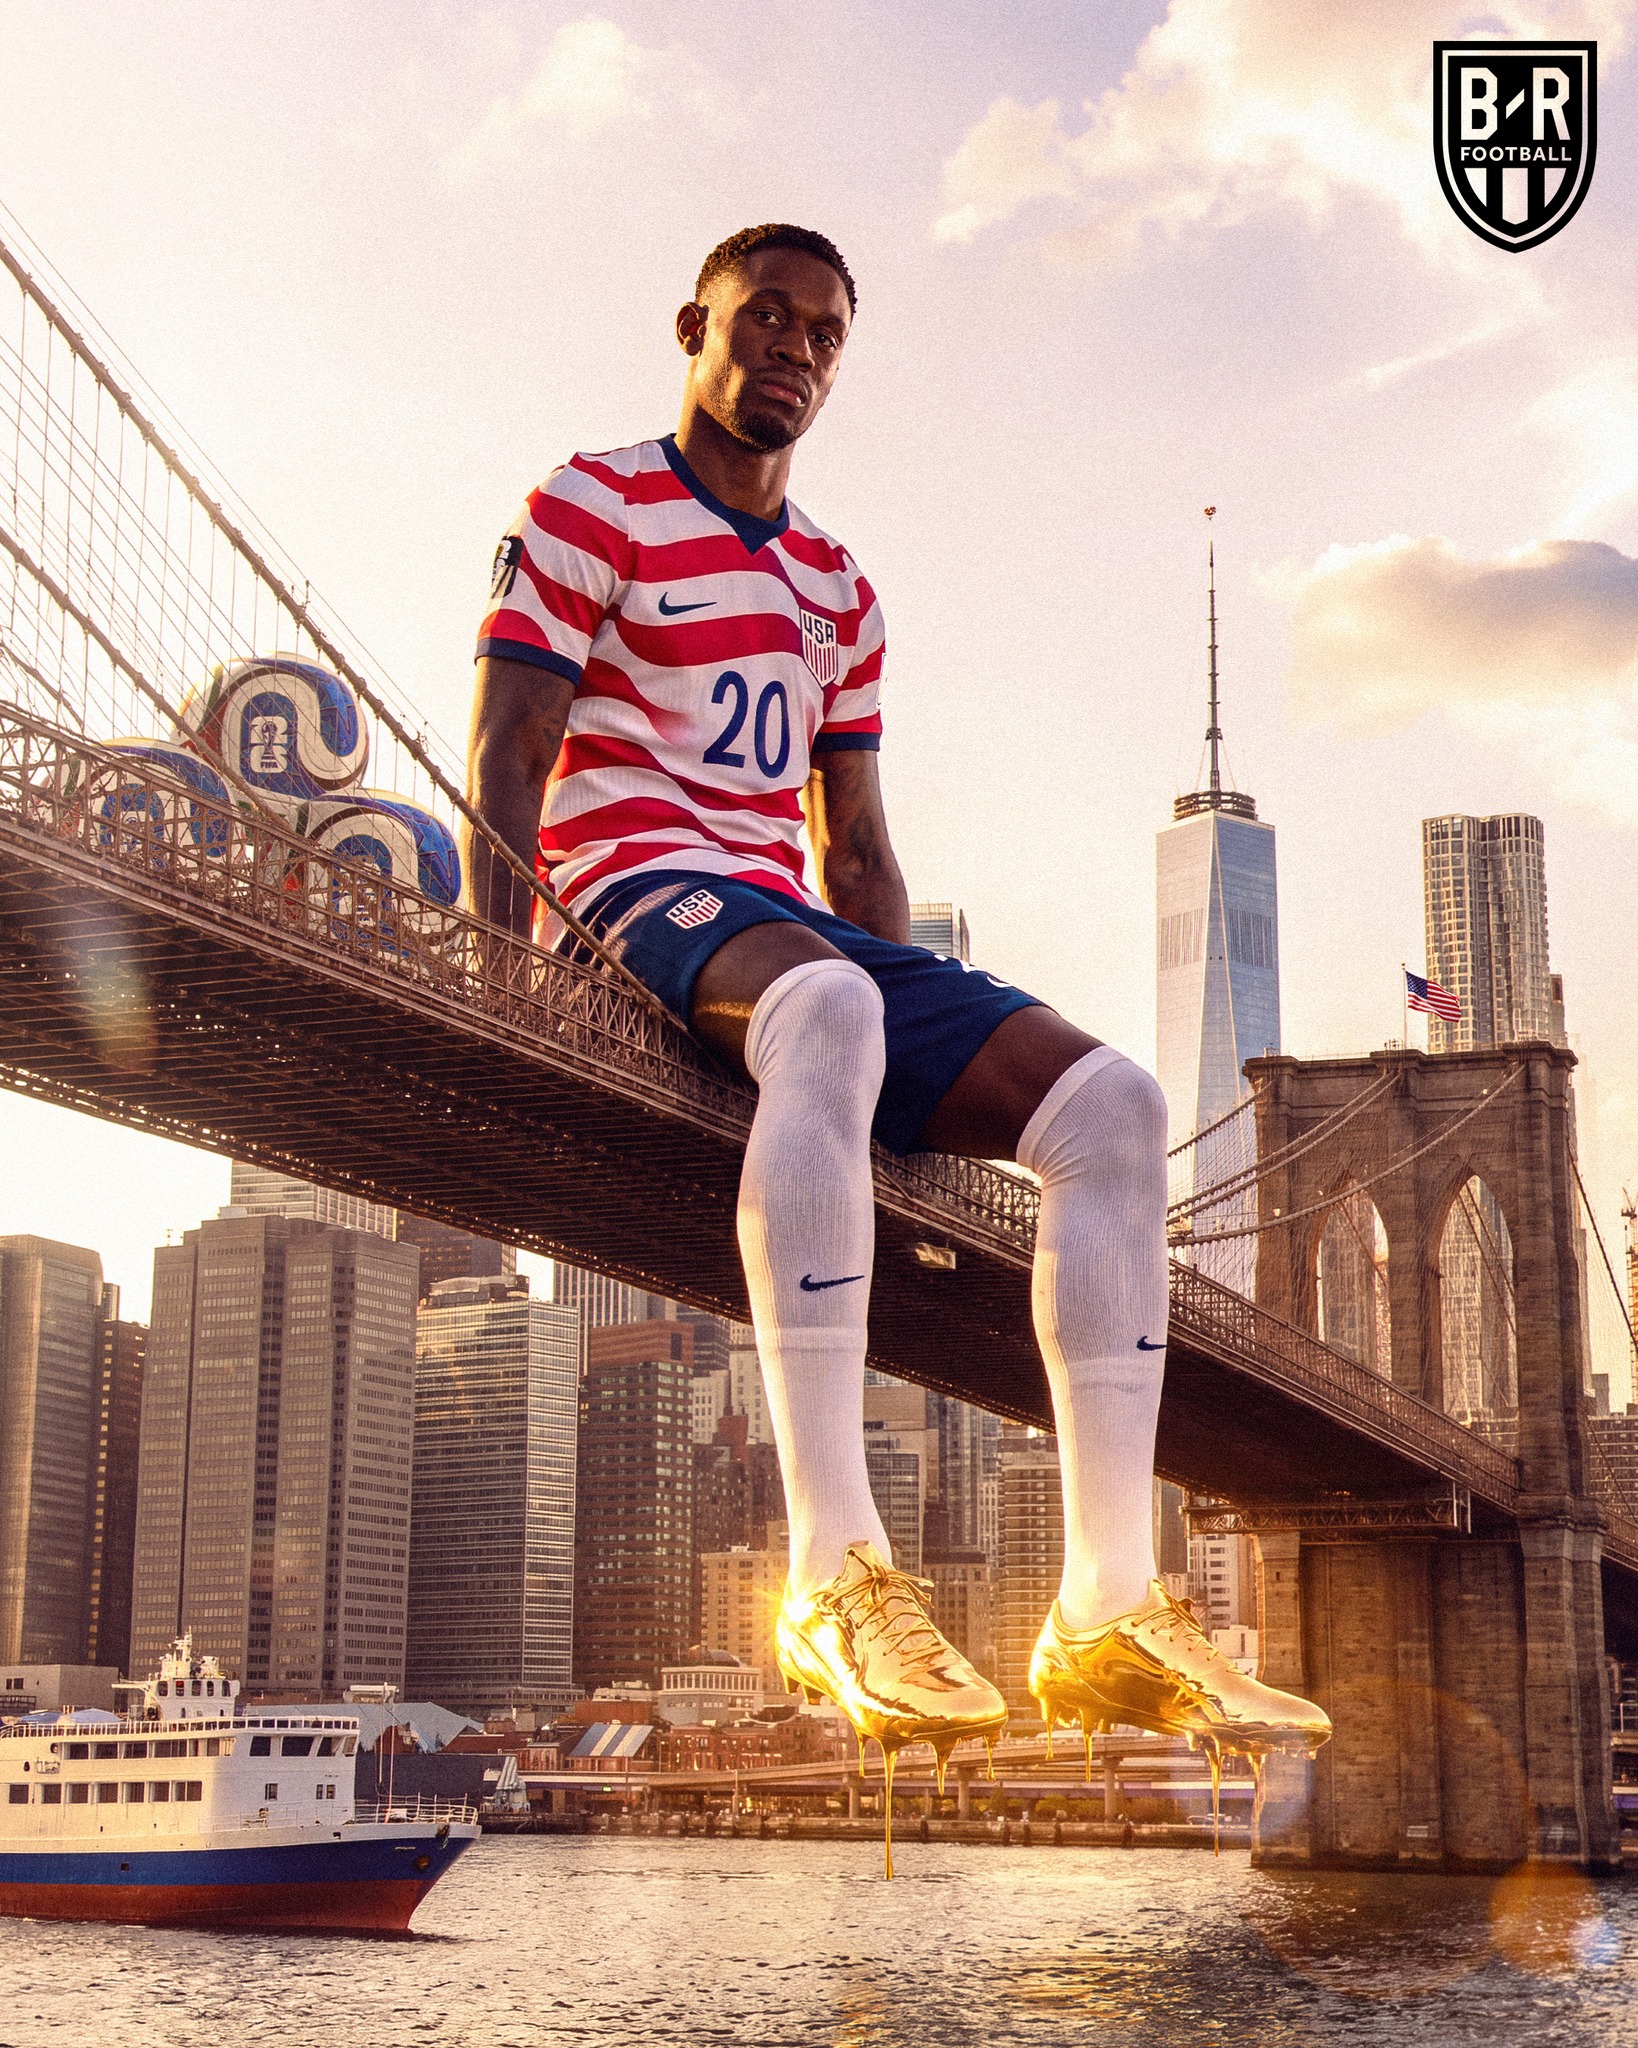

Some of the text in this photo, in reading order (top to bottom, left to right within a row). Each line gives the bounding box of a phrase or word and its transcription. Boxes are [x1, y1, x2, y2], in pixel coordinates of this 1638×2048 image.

[803, 613, 834, 645] USA
[702, 670, 790, 778] 20
[669, 892, 708, 918] USA
